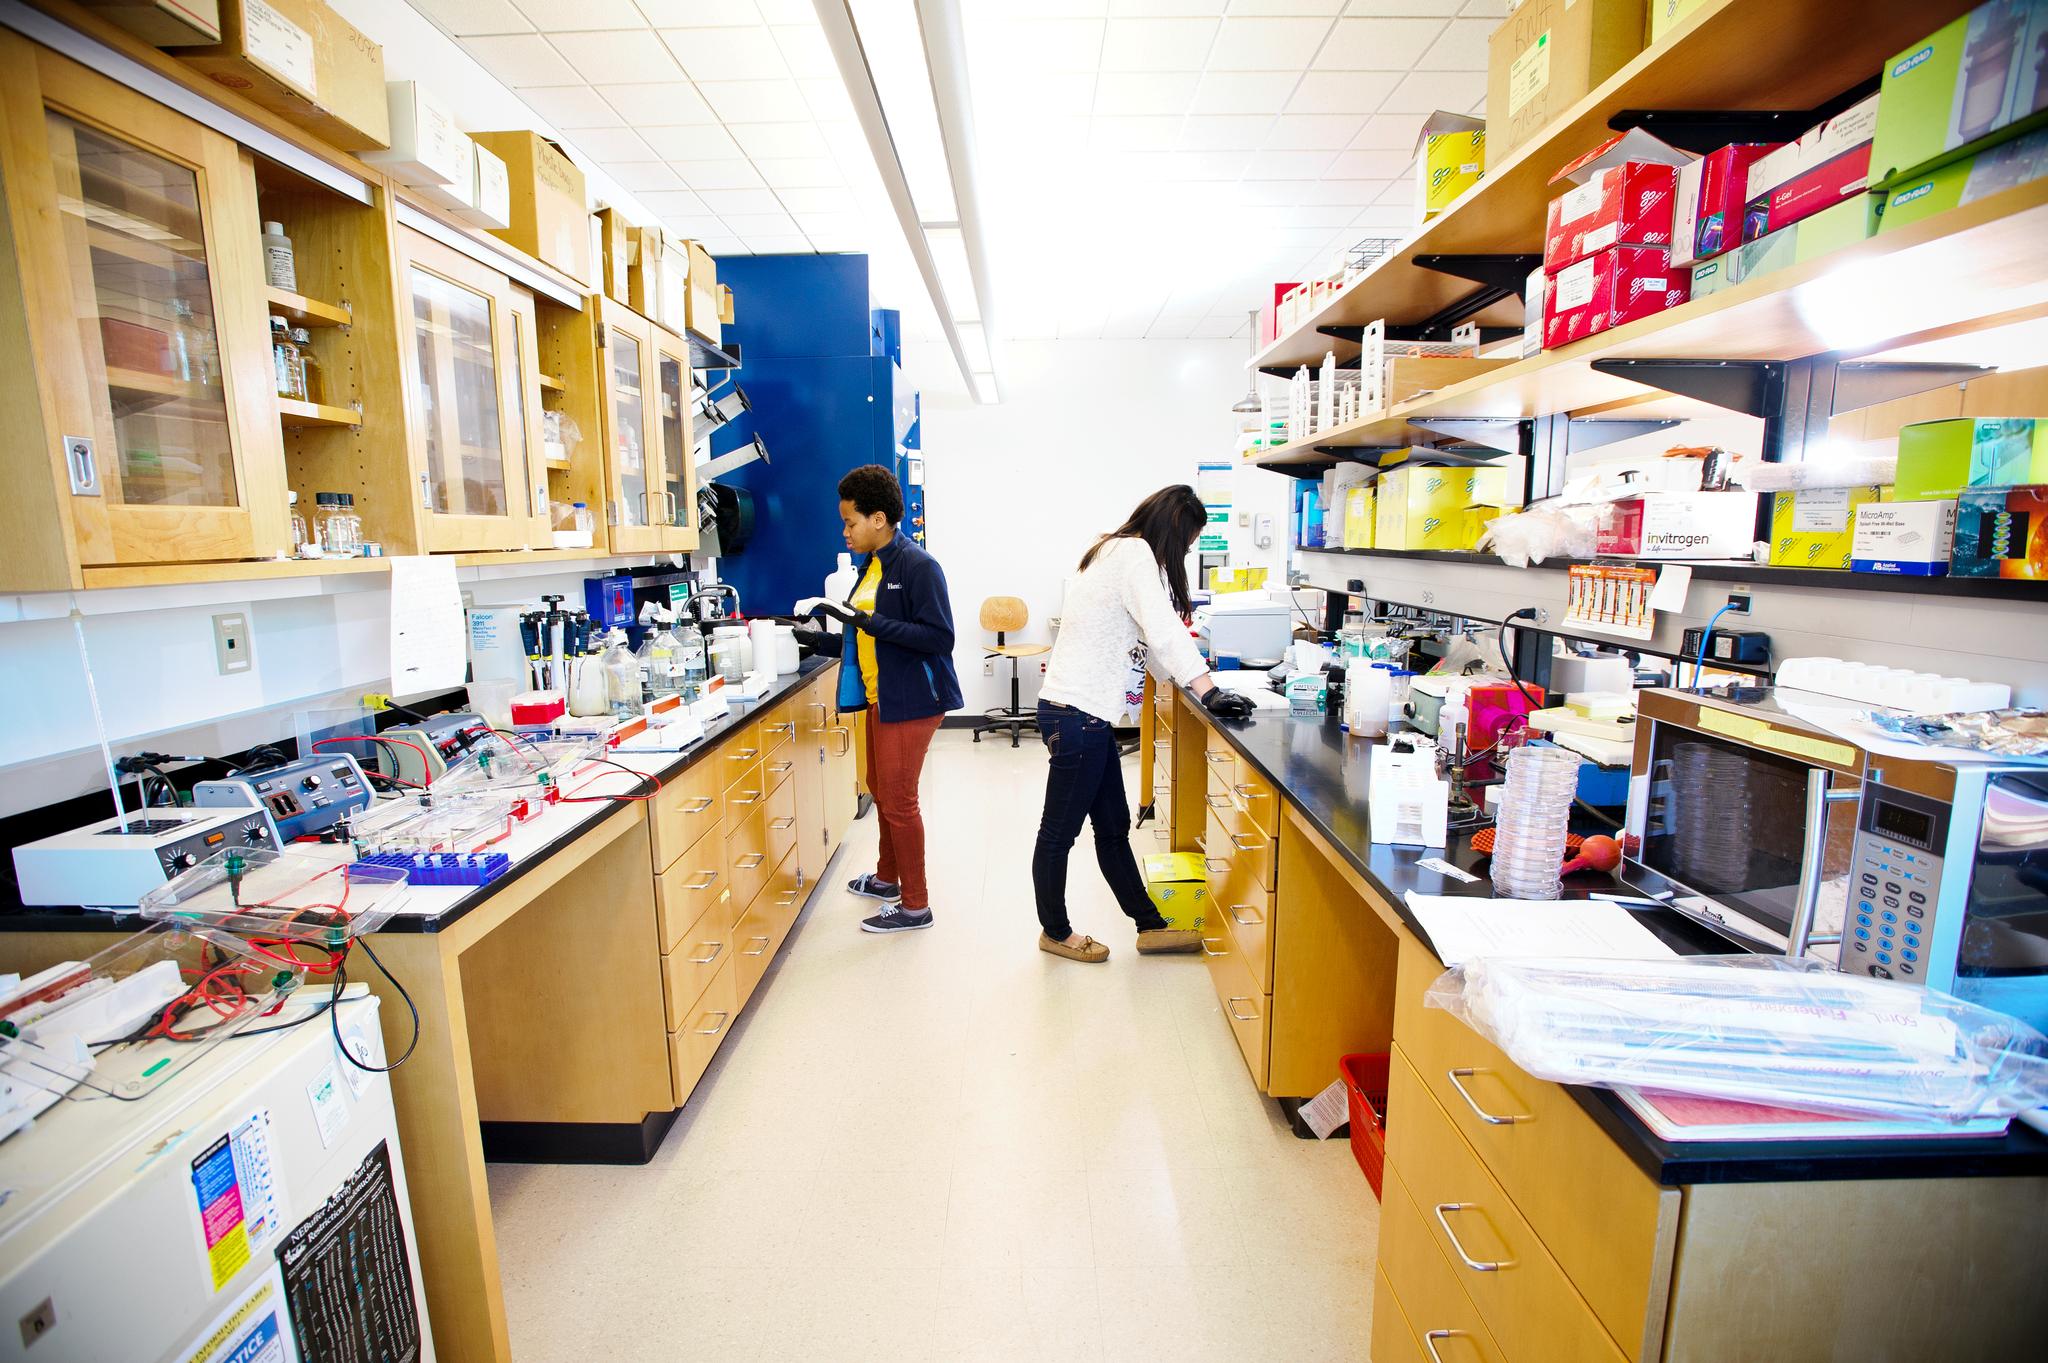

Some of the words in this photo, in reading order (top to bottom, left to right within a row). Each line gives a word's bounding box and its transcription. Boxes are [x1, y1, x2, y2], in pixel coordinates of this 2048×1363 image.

[1894, 49, 1931, 75] BIO-RAD
[1894, 184, 1932, 205] BIO-RAD
[1696, 265, 1716, 279] BIO-RAD
[290, 1204, 326, 1243] NEBuffer
[327, 1186, 351, 1213] Activity
[350, 1166, 365, 1186] Chart
[366, 1156, 374, 1170] for
[308, 1204, 346, 1243] Restriction
[346, 1160, 382, 1206] Endonucleases
